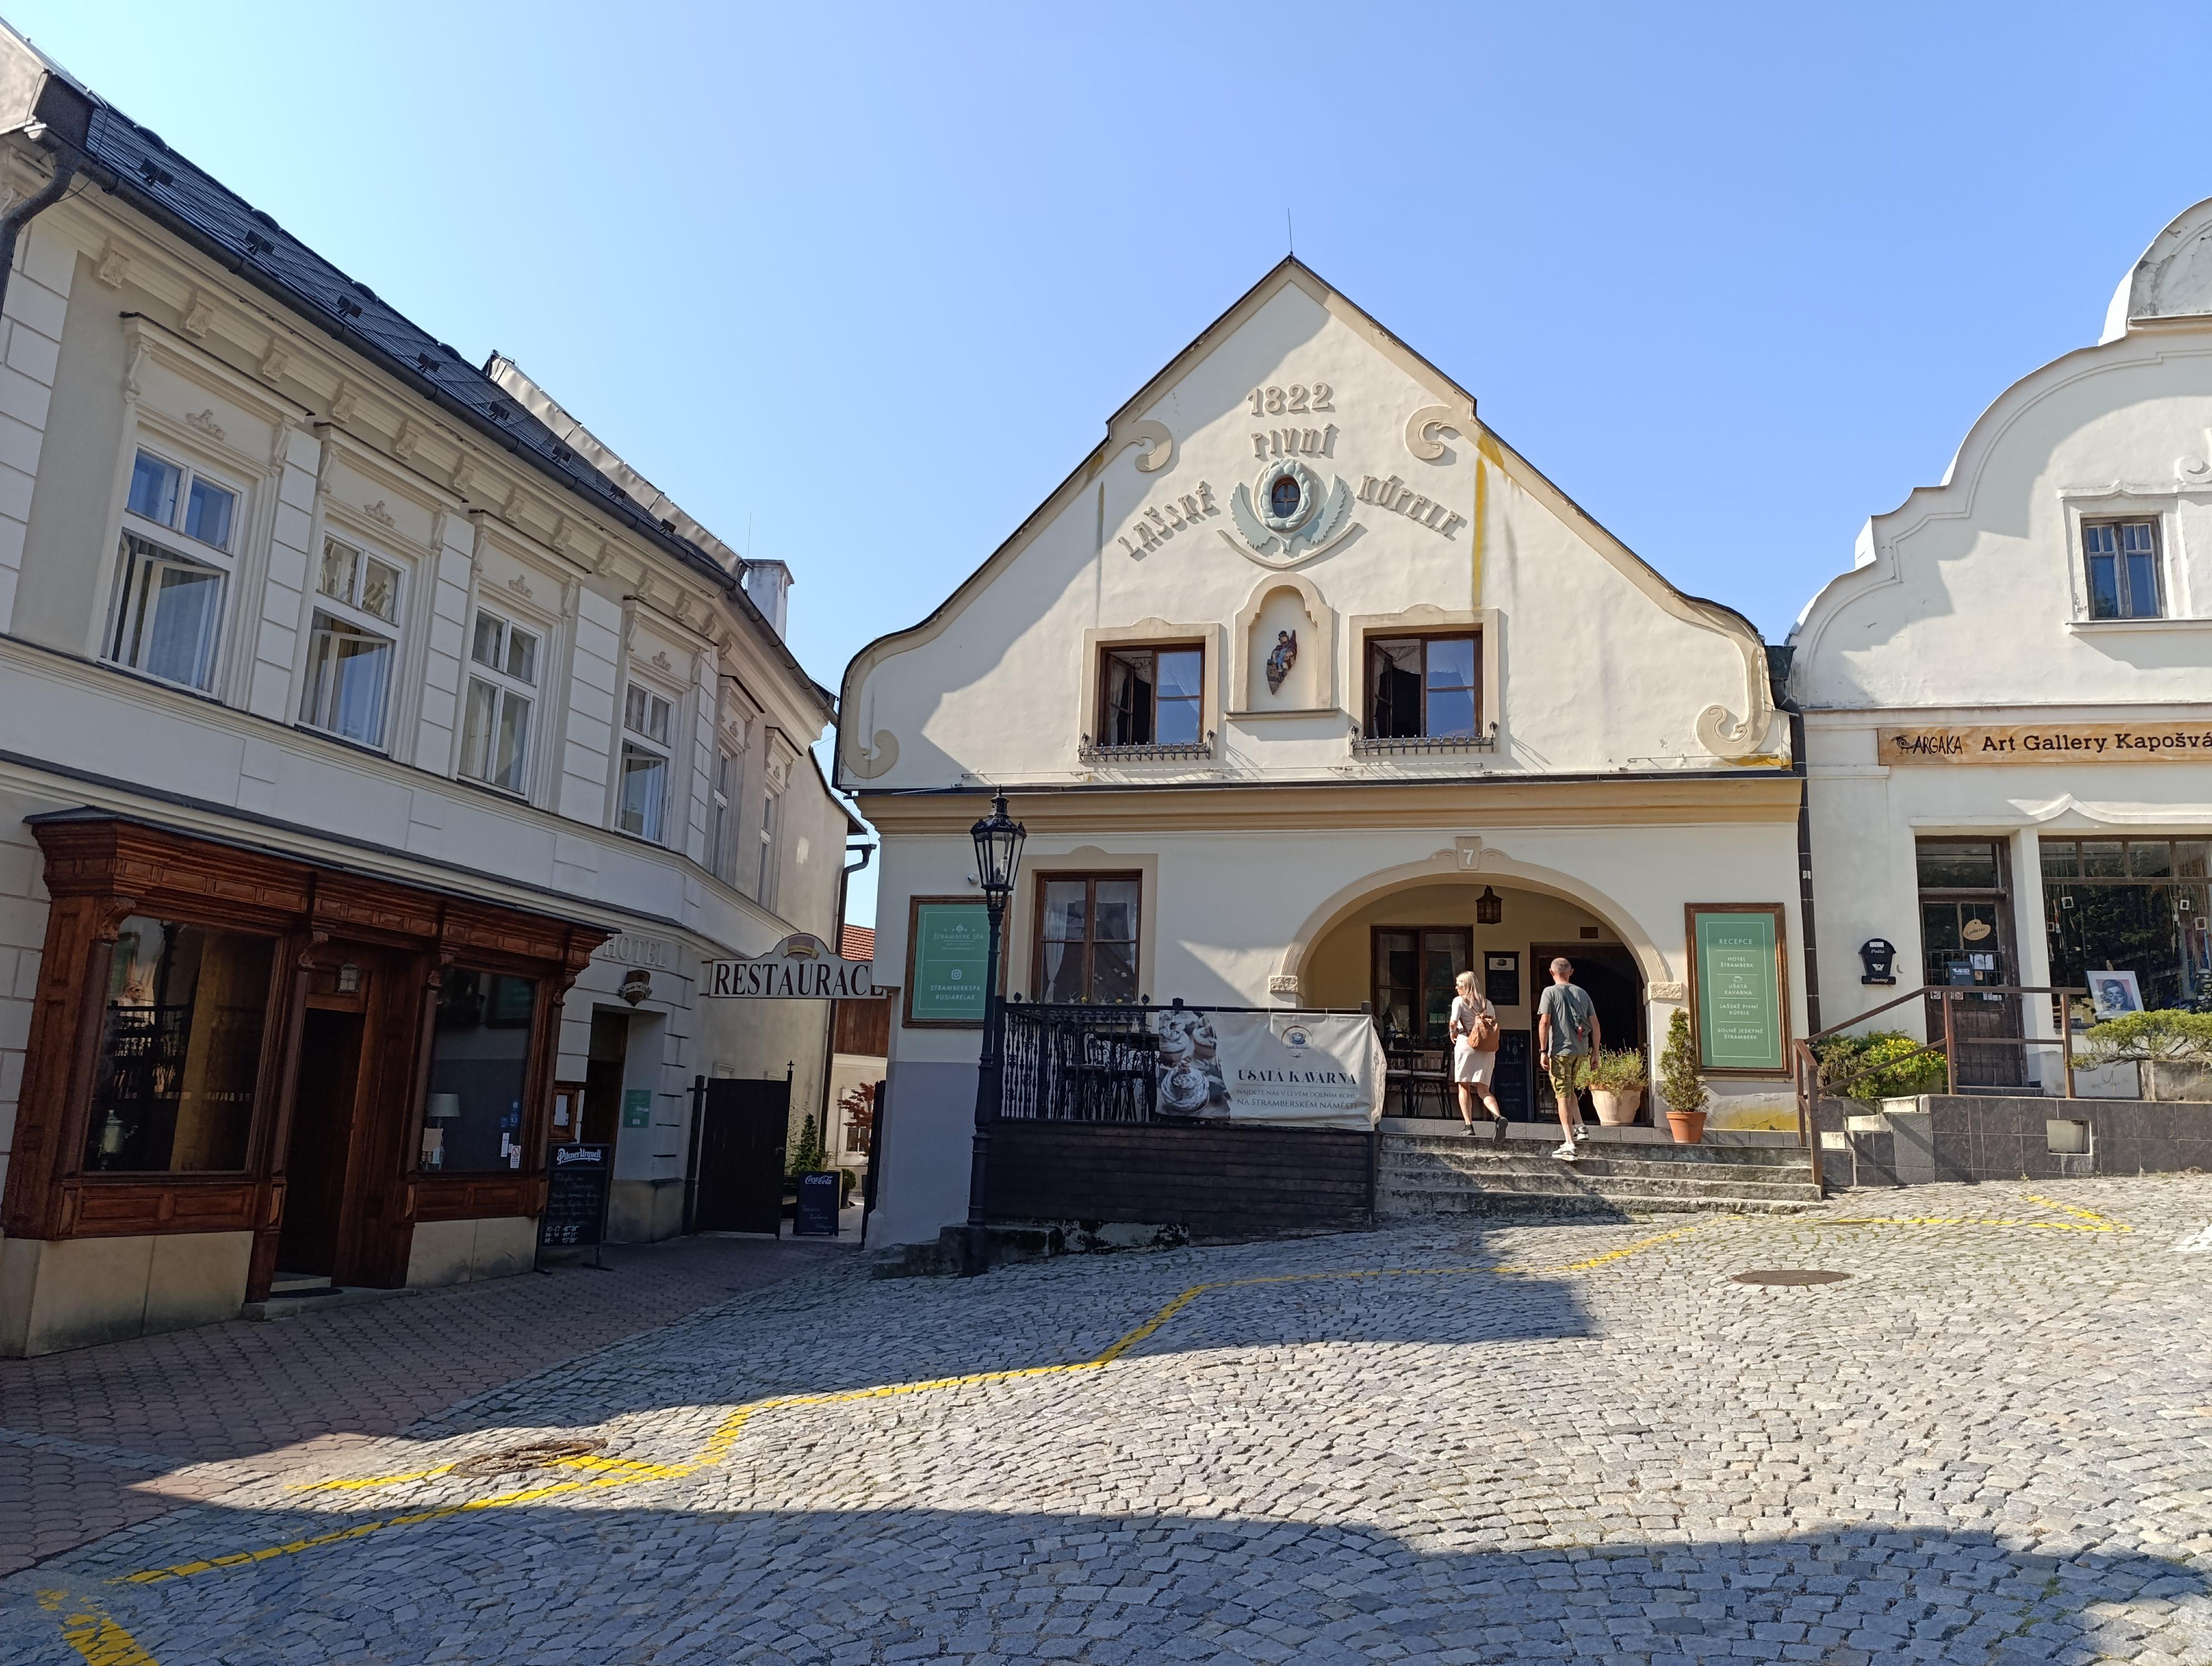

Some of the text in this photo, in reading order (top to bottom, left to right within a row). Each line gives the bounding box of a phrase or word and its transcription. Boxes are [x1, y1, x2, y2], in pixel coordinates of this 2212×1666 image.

[1247, 382, 1329, 414] 1822
[1251, 423, 1333, 457] PIVNÍ
[1117, 480, 1213, 558] LAŠSKÉ
[1913, 732, 2212, 755] ARGAKA Art Gallery Kapošvá
[1464, 849, 1474, 866] 7
[604, 934, 666, 967] HOTEL
[1238, 1067, 1357, 1084] UŠATÁ KAVÁRNA
[1251, 1098, 1318, 1108] ŠTRAMBERSKÉM
[1320, 1101, 1358, 1110] NÁMĚSTÍ
[557, 1148, 602, 1165] Pilsner Urquell
